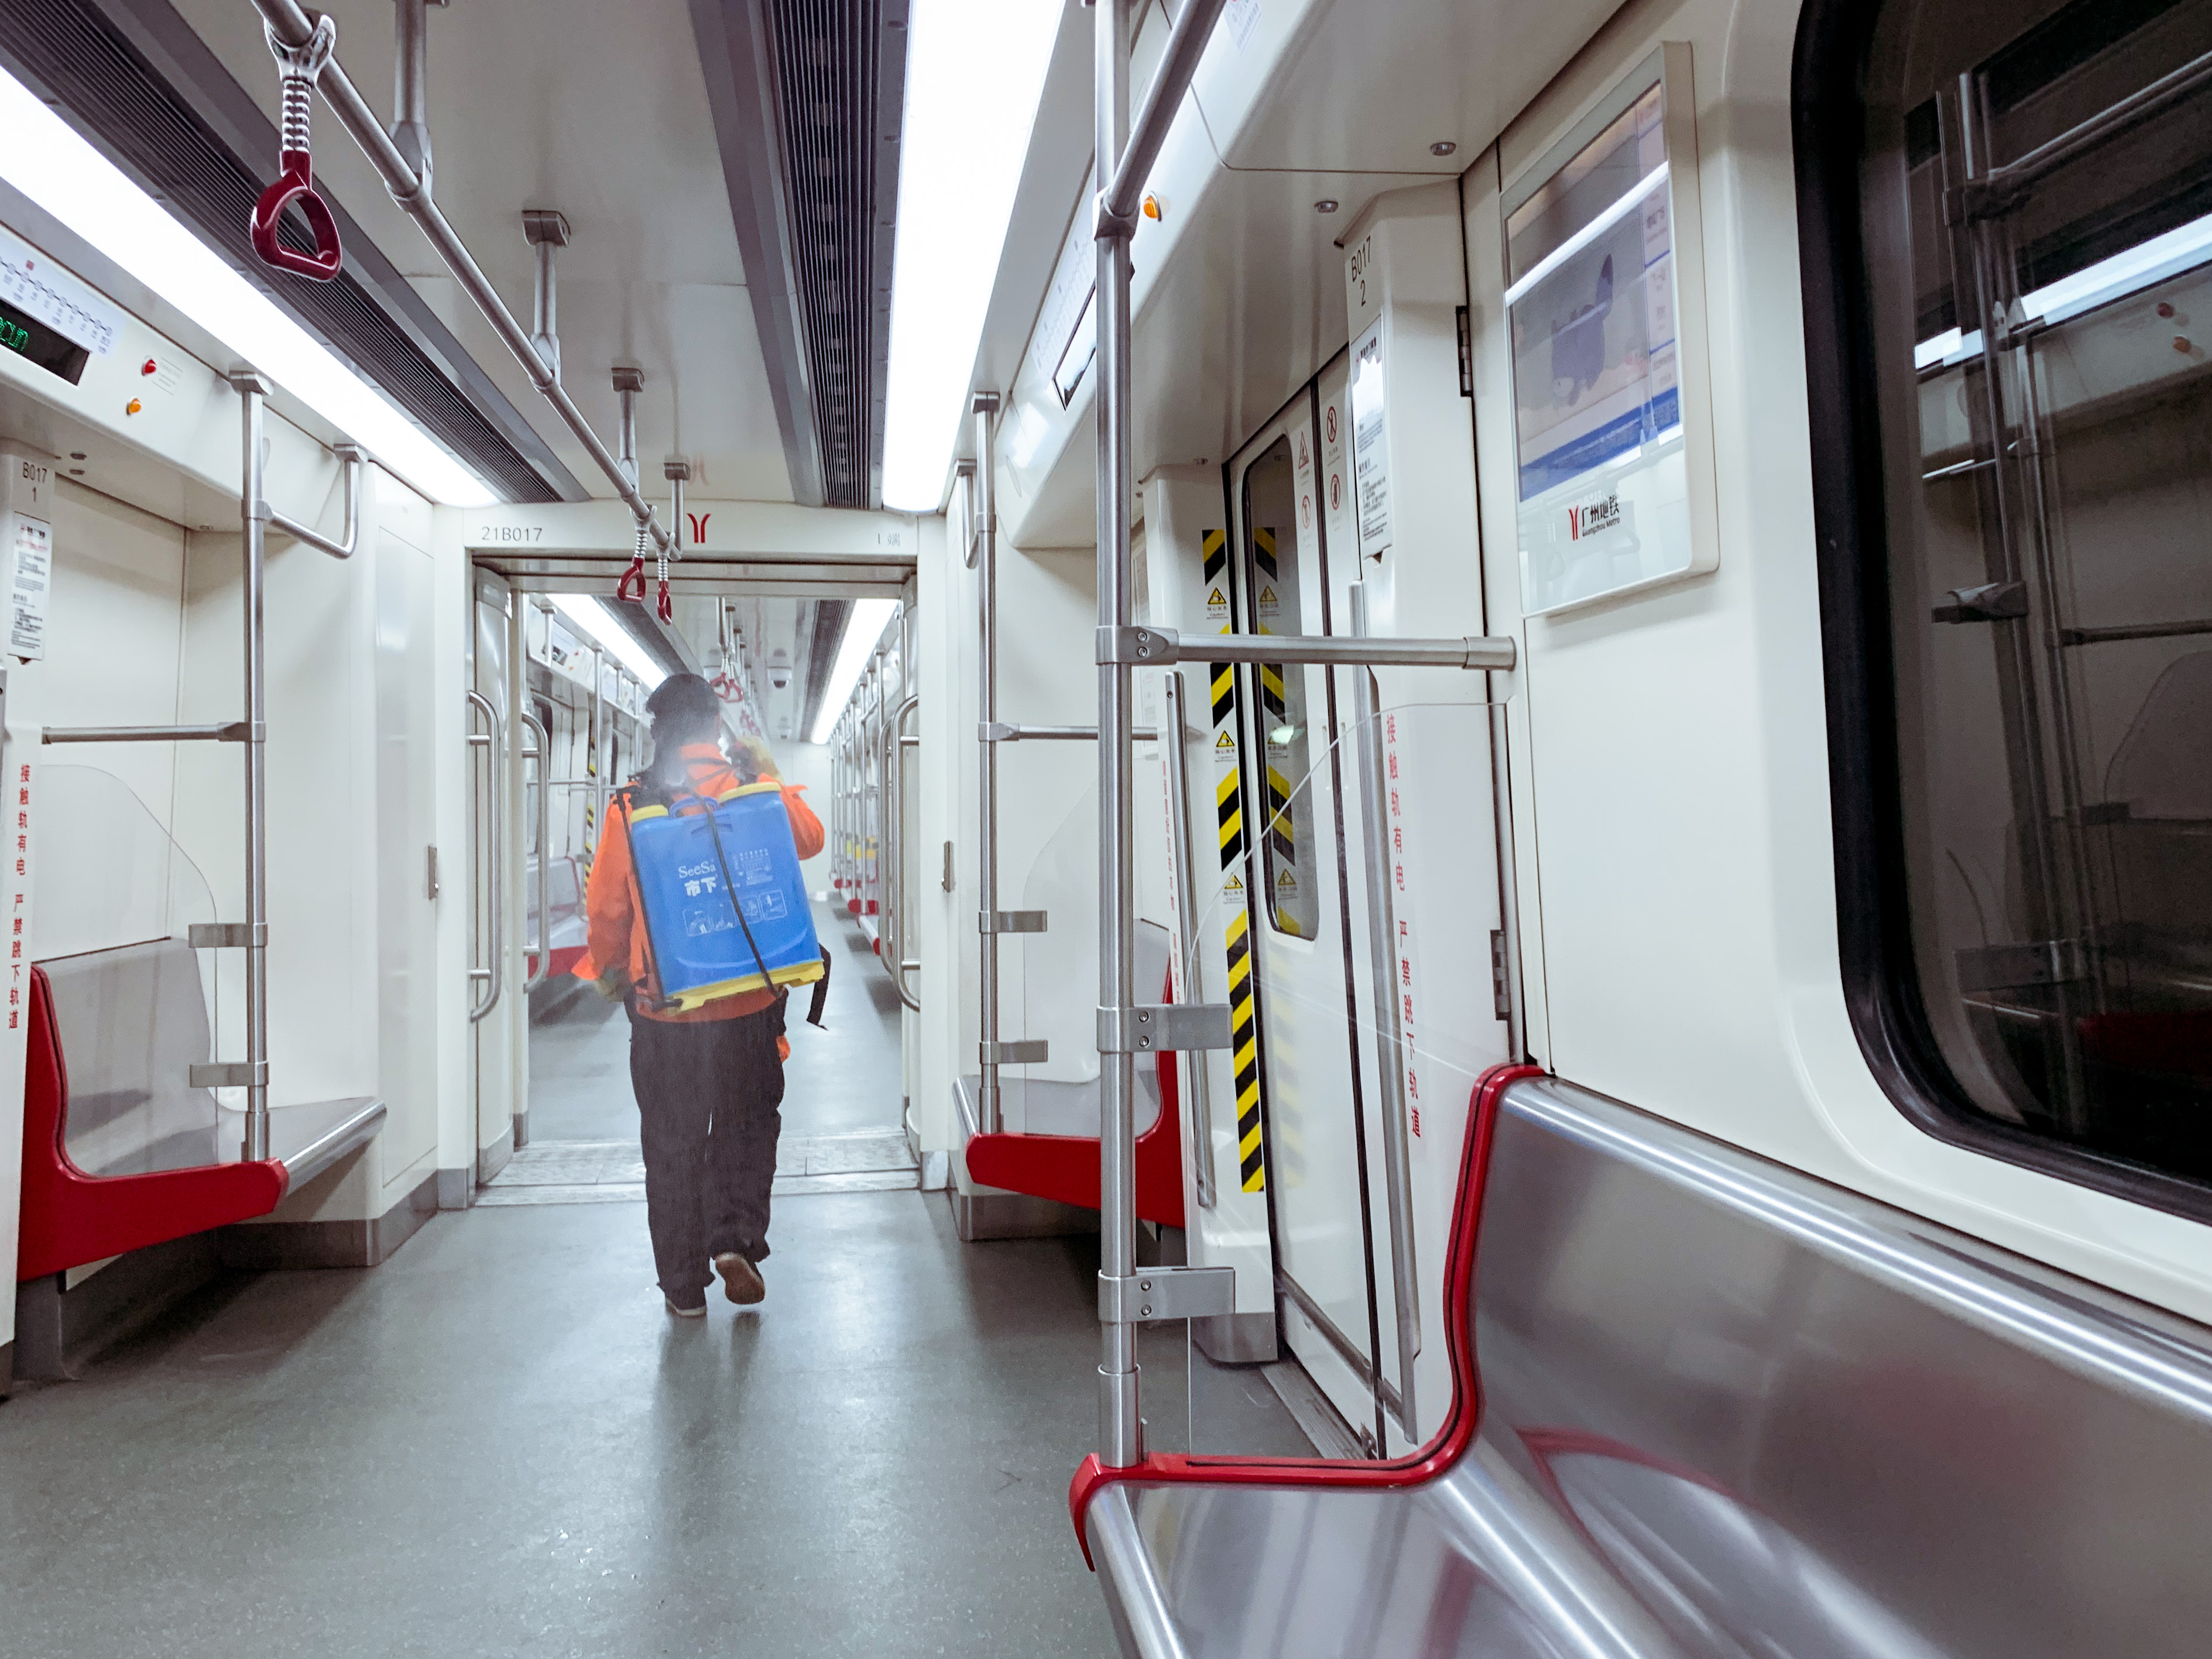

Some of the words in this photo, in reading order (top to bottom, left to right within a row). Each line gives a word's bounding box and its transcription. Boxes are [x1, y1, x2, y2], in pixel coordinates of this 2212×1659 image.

[1352, 234, 1371, 283] B017
[1360, 279, 1367, 307] 2
[22, 461, 47, 484] B017
[32, 486, 37, 502] 1
[1582, 495, 1620, 527] 广州地铁
[481, 525, 543, 542] 21B017
[1582, 523, 1606, 537] Guangzhou
[1606, 517, 1620, 528] Metro
[16, 763, 30, 876] 接触轨有电
[678, 861, 716, 878] SeeSa
[684, 876, 716, 897] 市下
[1386, 714, 1405, 892] 接触轨有电
[1399, 920, 1421, 1138] 严禁跳下轨道
